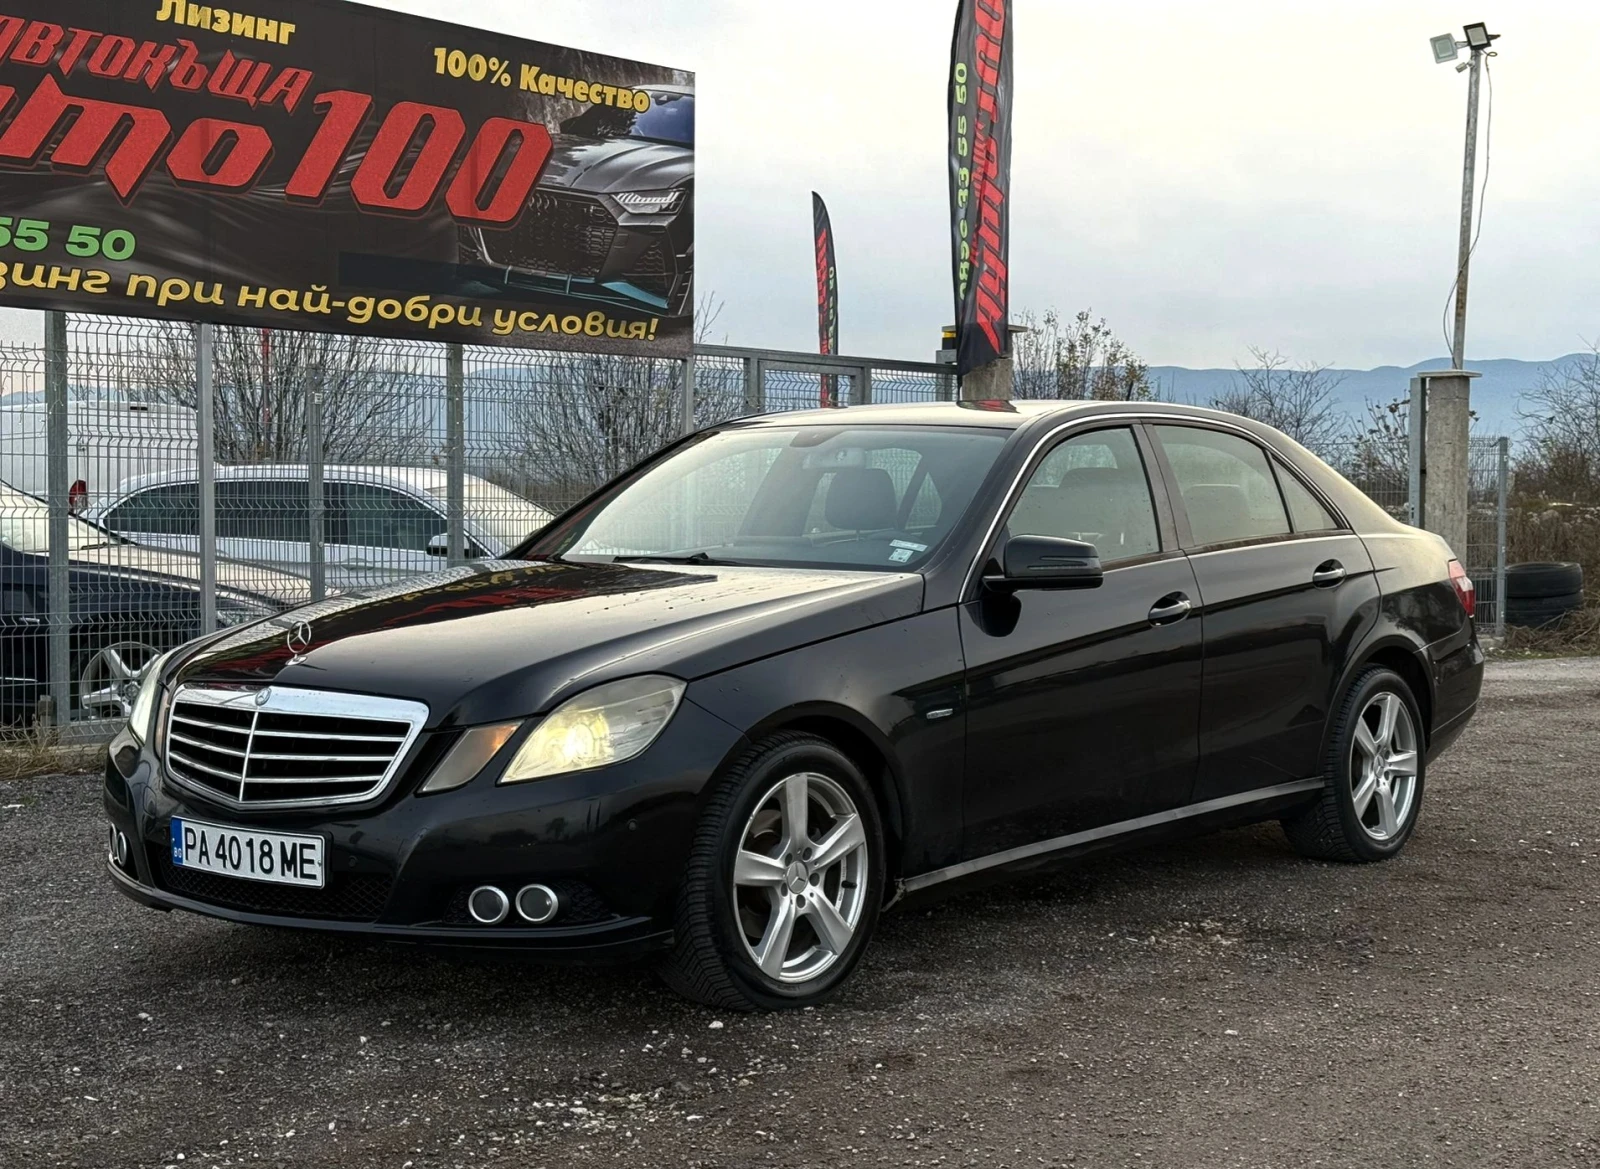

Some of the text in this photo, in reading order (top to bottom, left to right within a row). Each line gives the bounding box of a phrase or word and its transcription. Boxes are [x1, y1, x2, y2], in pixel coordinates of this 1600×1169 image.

[156, 0, 296, 45] Лизинг
[434, 47, 651, 113] 100% Качество
[955, 62, 967, 105] 50
[285, 89, 553, 222] 100
[957, 115, 968, 157] 55
[958, 167, 970, 209] 33
[65, 224, 136, 261] 50
[126, 273, 224, 307] при
[237, 284, 482, 330] най-добри
[492, 310, 659, 341] условия!
